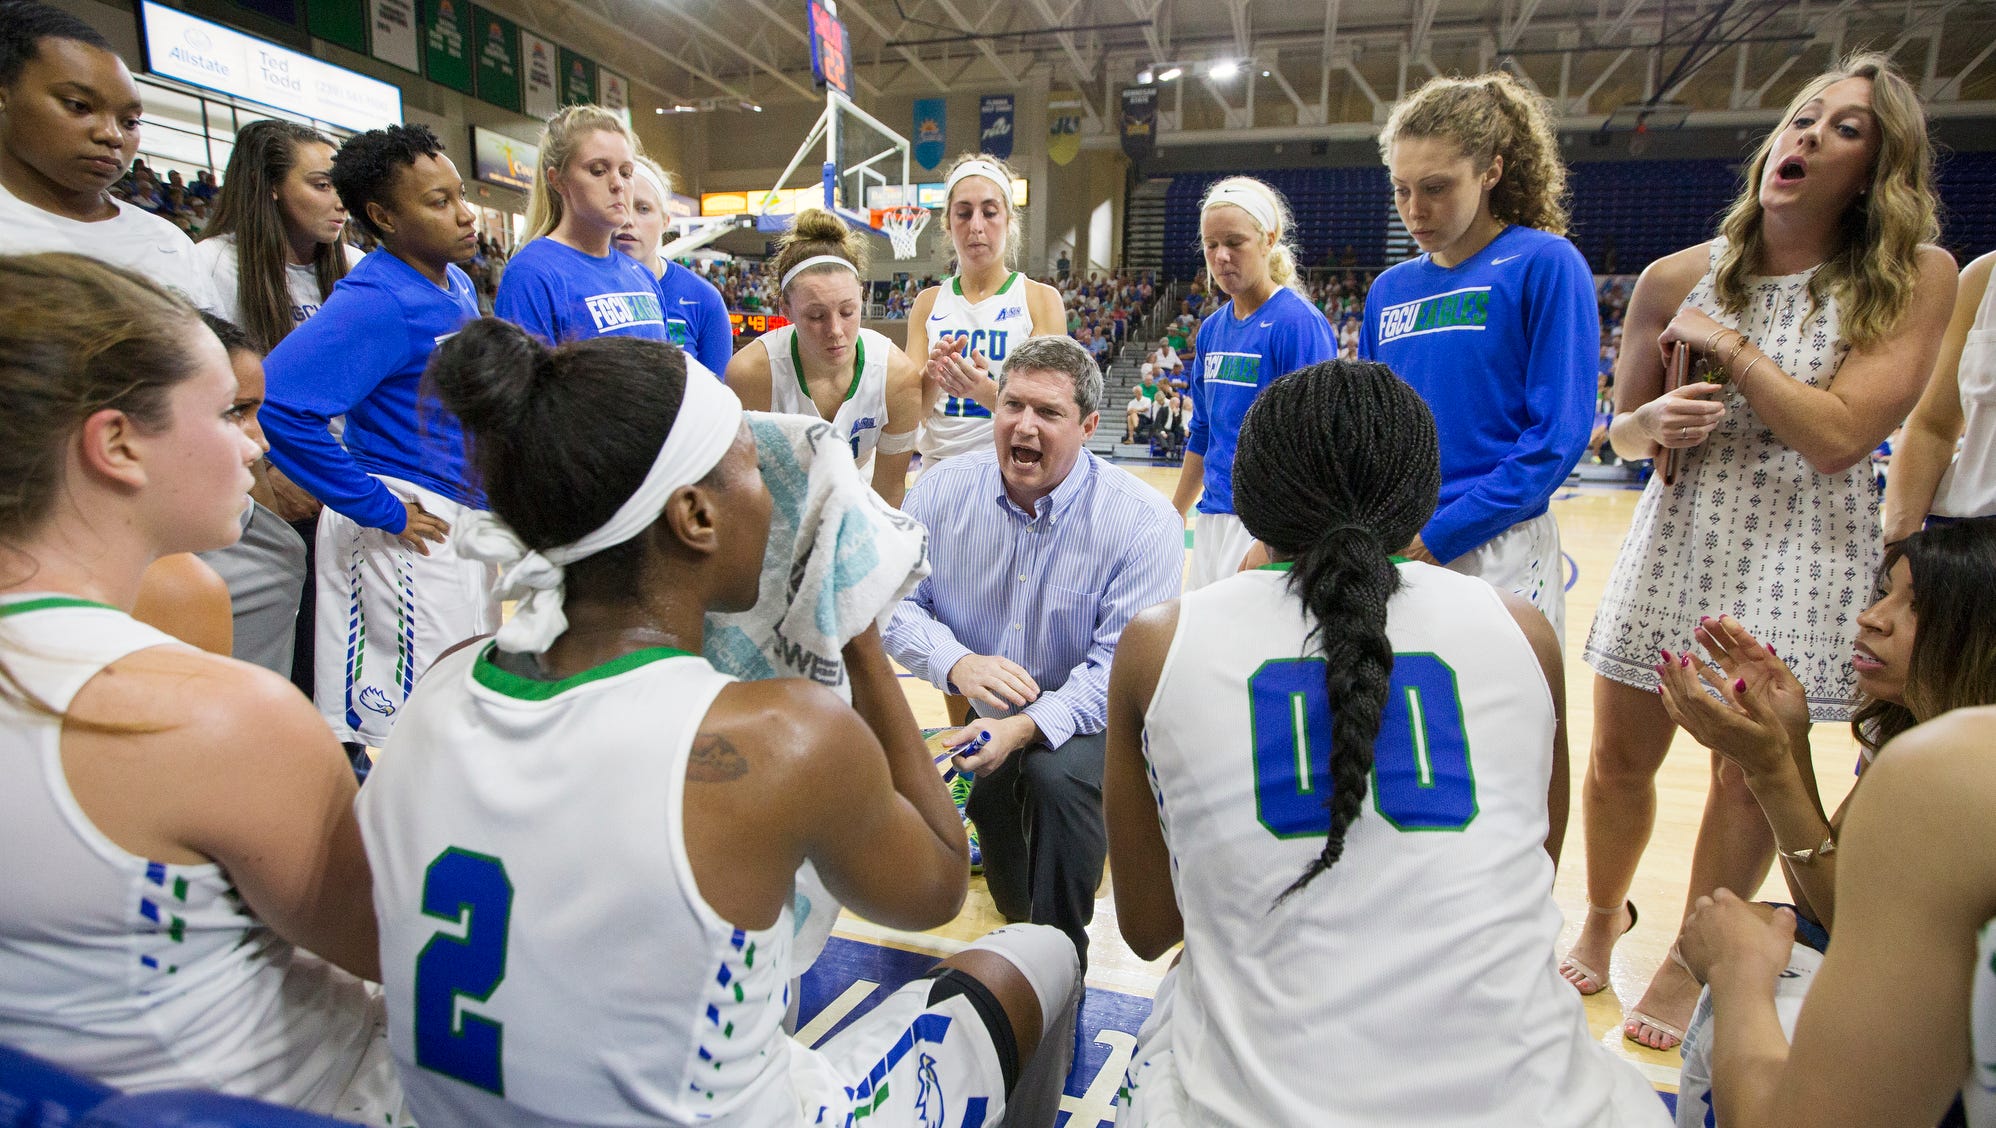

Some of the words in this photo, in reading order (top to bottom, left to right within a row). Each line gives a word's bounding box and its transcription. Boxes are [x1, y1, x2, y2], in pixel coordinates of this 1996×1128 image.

[168, 46, 231, 77] Allstate
[258, 48, 290, 73] Ted
[260, 66, 302, 91] Todd
[747, 315, 766, 333] 43
[1247, 652, 1480, 840] 00
[413, 845, 515, 1098] 2
